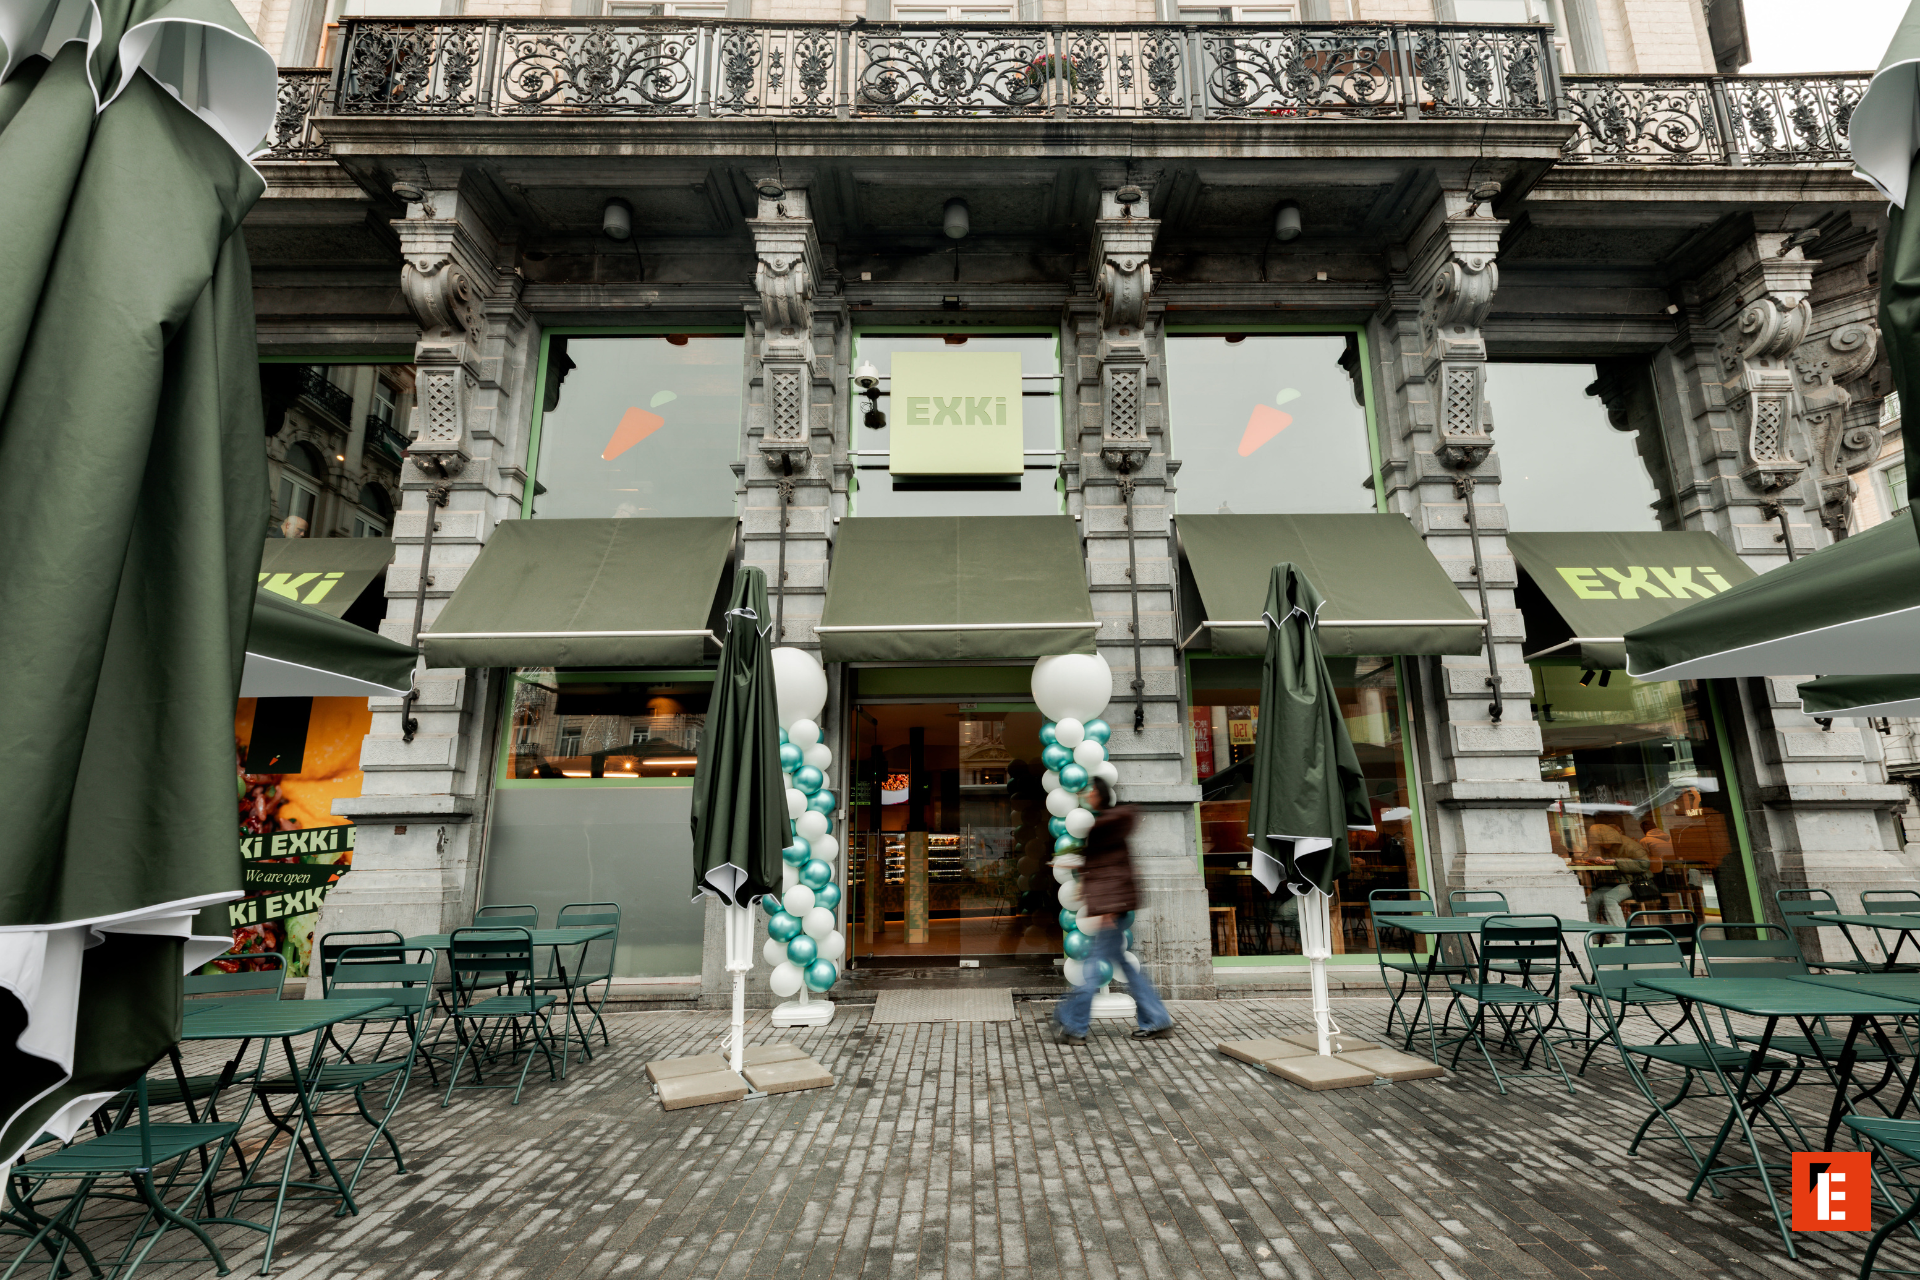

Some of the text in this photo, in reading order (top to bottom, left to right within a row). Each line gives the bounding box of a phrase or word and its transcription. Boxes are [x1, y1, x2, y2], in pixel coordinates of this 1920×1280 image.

[907, 396, 1007, 426] EXKi
[1555, 566, 1733, 599] EXKi
[271, 829, 339, 857] EXKi
[246, 869, 311, 886] We are open
